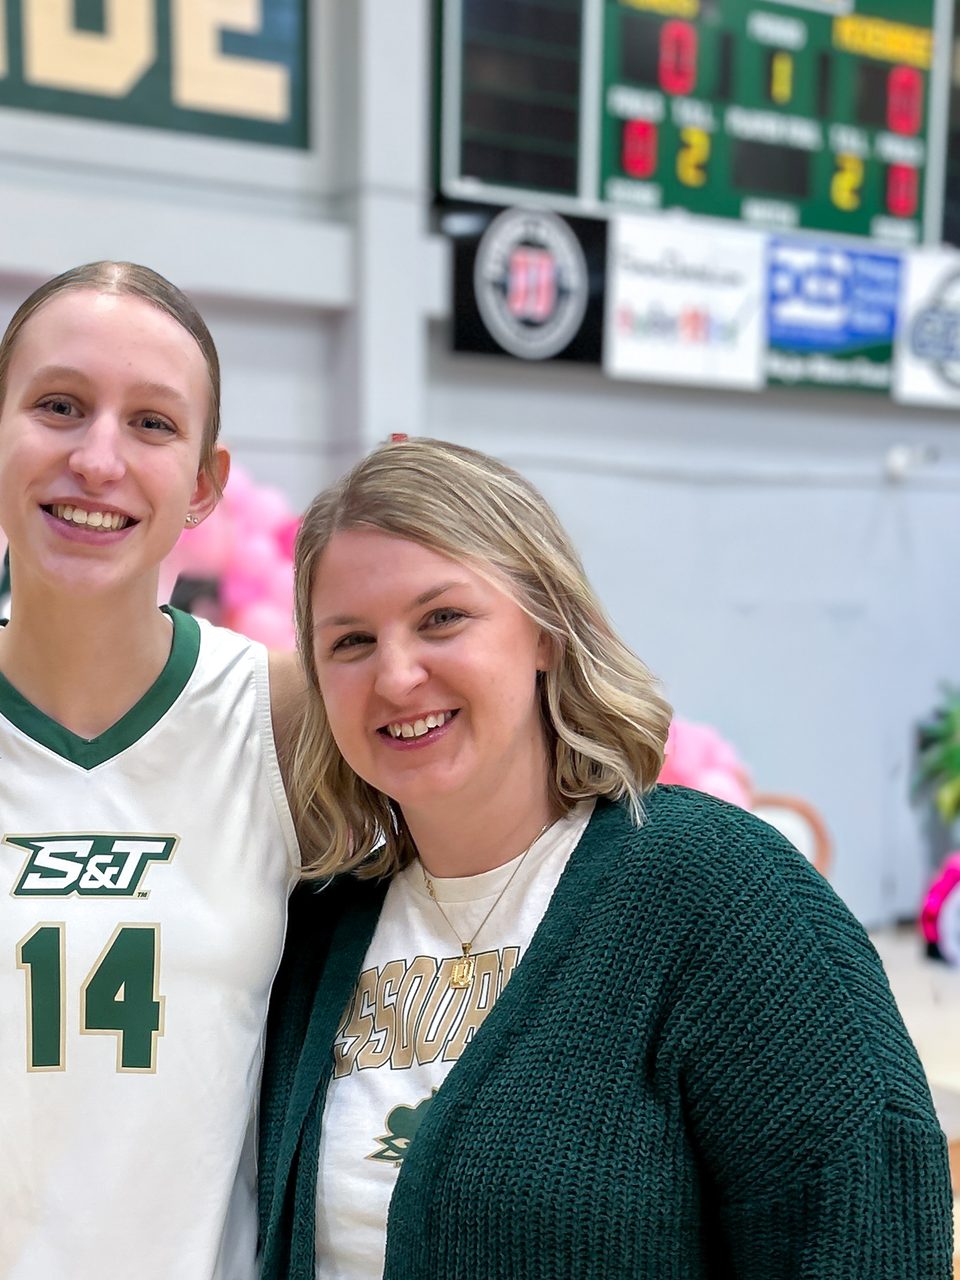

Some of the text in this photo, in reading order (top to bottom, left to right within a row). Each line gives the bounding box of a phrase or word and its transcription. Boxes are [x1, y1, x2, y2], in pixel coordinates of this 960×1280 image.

[658, 20, 697, 96] 0
[771, 52, 793, 105] 1
[676, 126, 710, 187] 2
[831, 154, 864, 211] 2
[17, 838, 169, 891] S&T
[15, 922, 166, 1074] 14
[332, 945, 522, 1080] SSOUR
